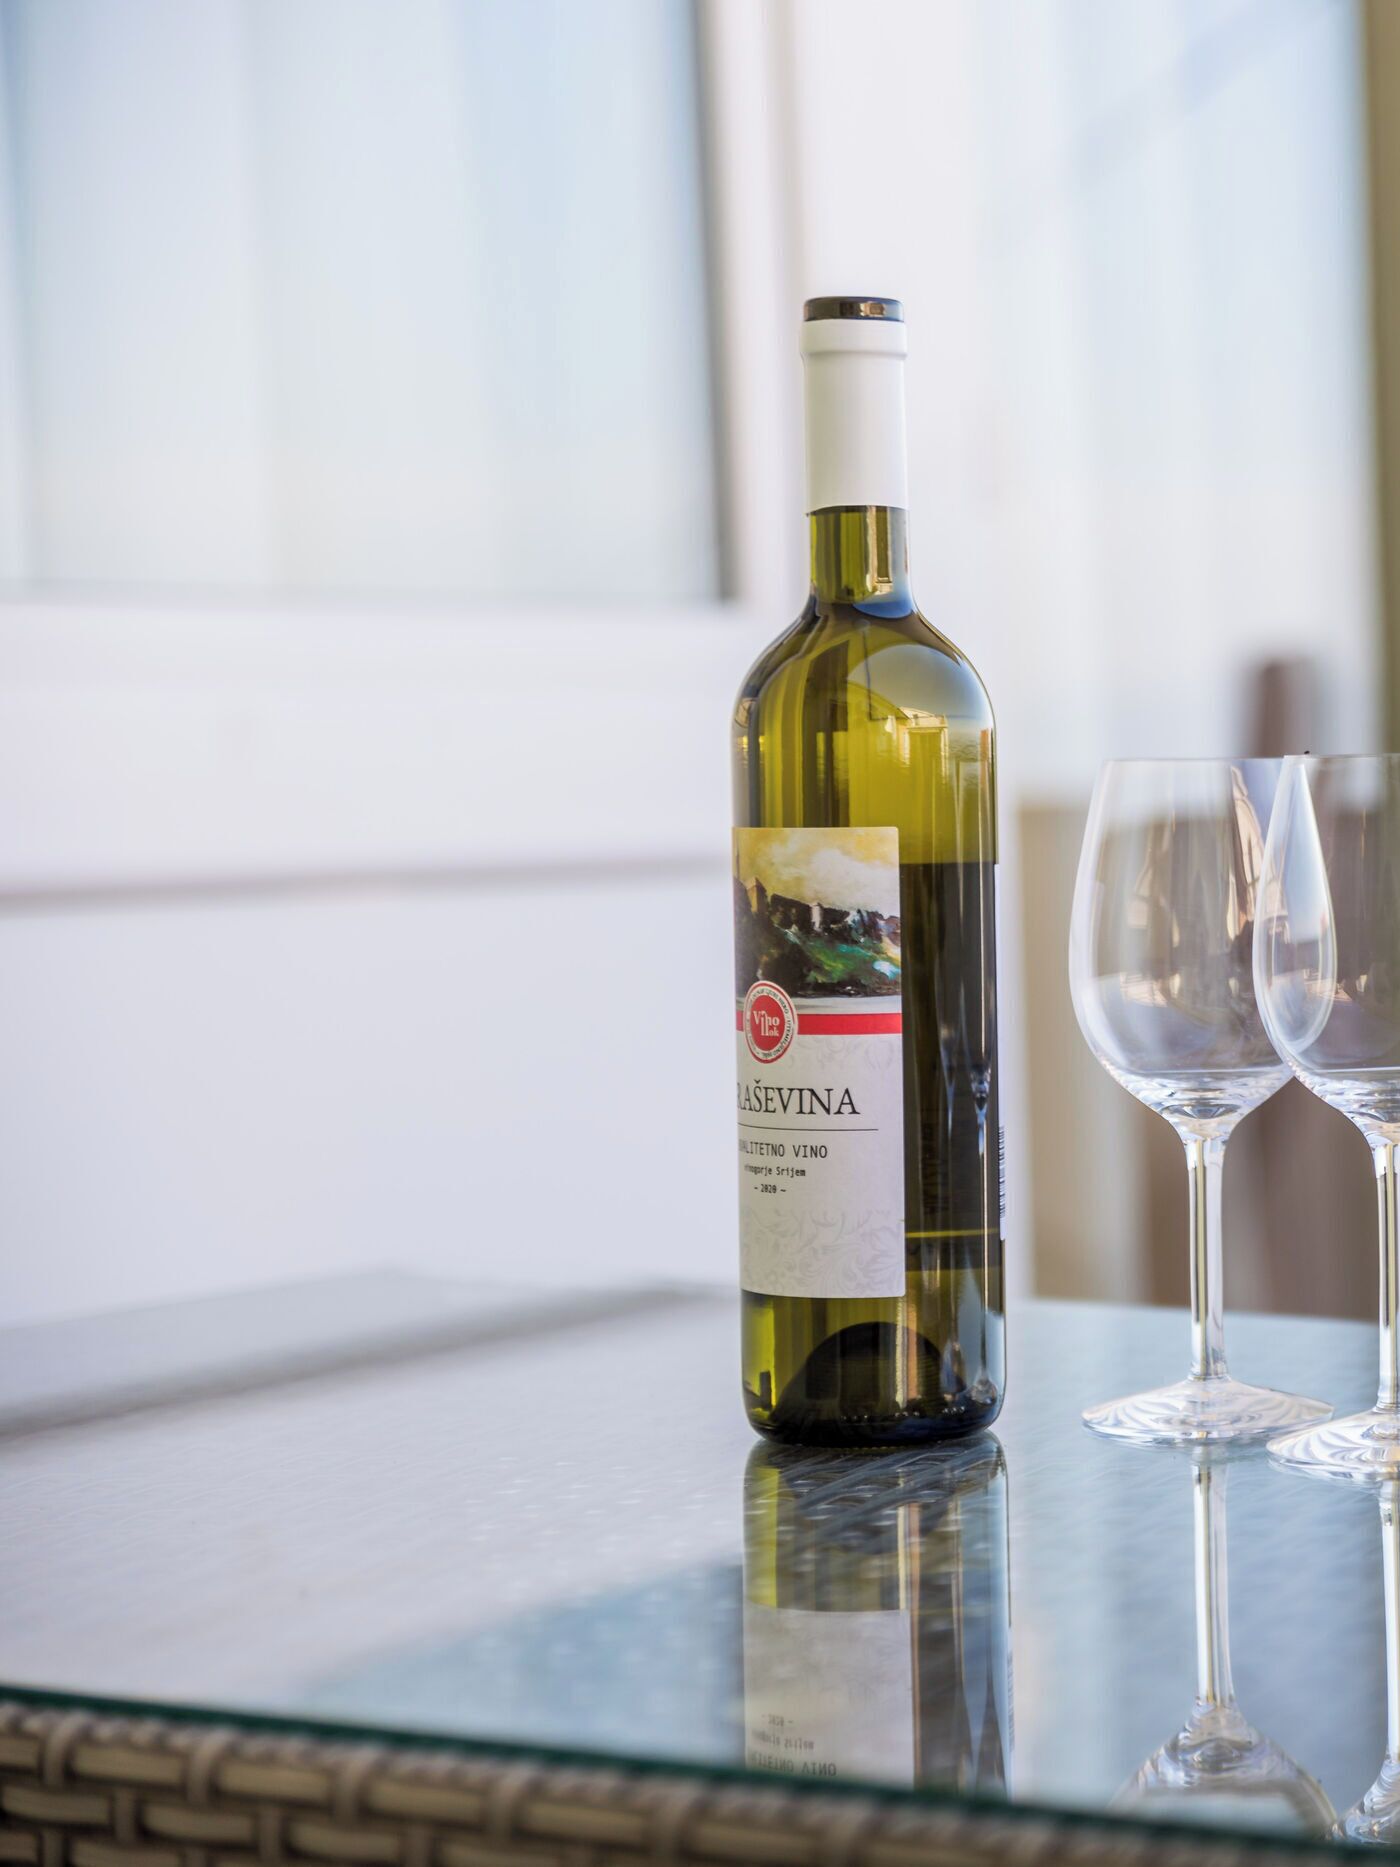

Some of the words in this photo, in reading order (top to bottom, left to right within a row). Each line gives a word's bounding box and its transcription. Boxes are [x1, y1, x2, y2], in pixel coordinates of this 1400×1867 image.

[737, 1079, 860, 1115] RAŠEVINA
[792, 1145, 828, 1158] VINO
[776, 1167, 806, 1178] Srijem
[761, 1184, 777, 1194] 2020
